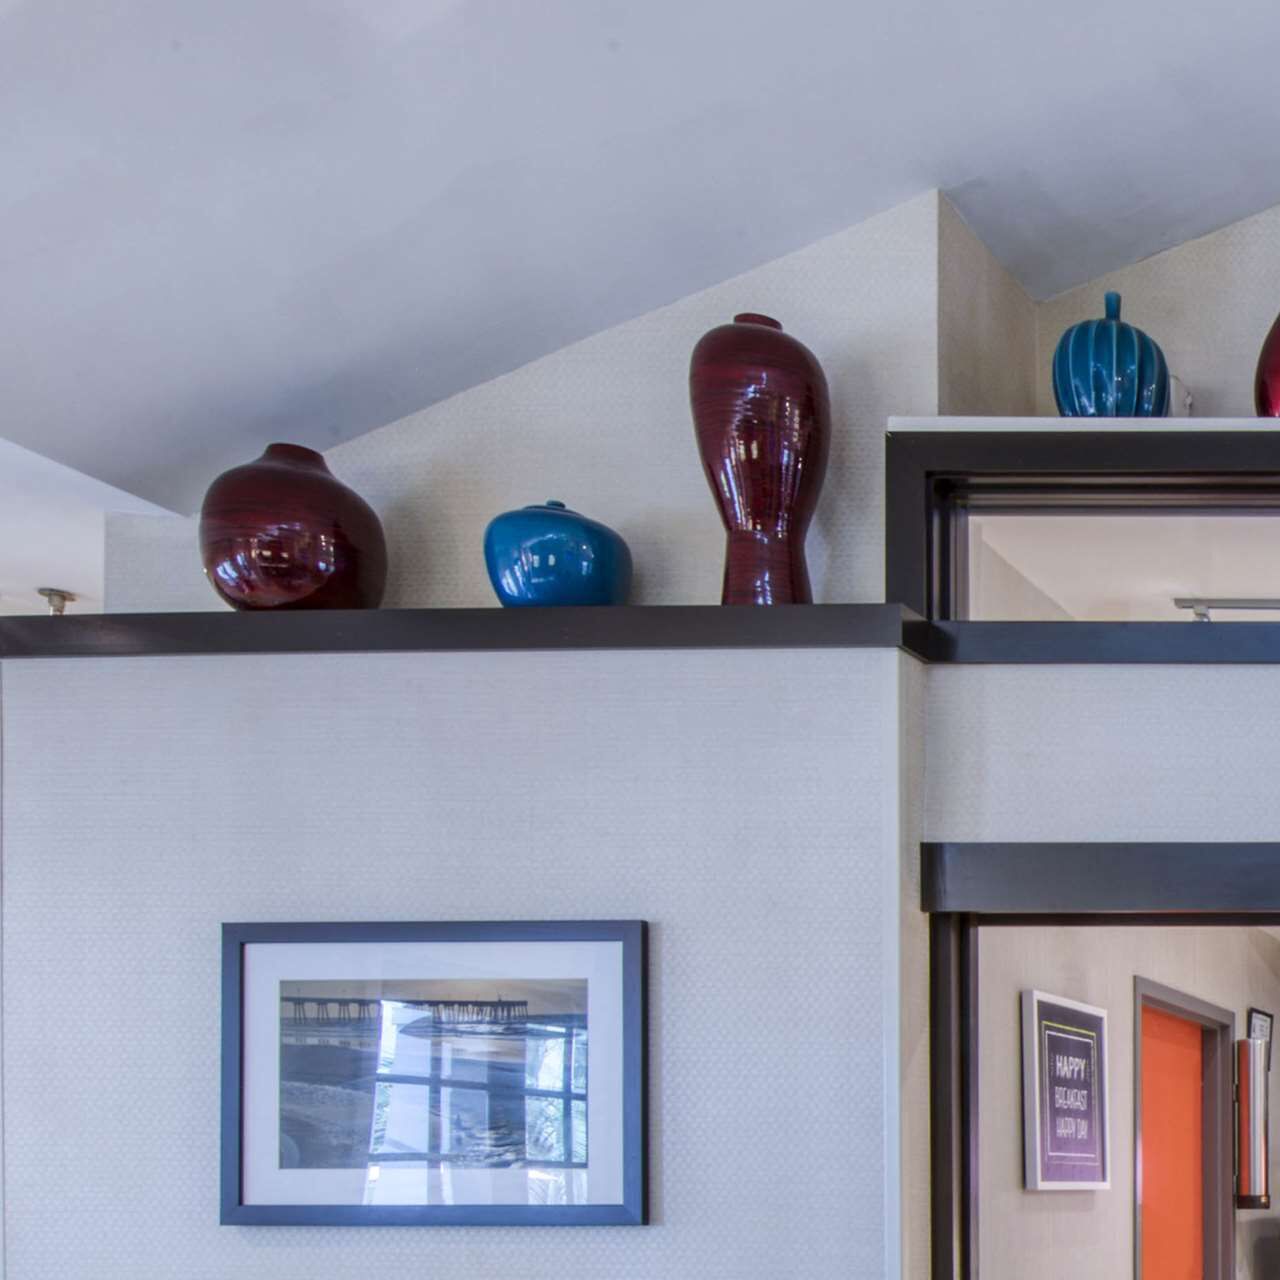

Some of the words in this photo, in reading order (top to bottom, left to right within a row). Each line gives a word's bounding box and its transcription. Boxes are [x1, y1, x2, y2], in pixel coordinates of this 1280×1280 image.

[1055, 1054, 1086, 1080] HAPPY
[1054, 1086, 1088, 1111] BREAKFAST
[1055, 1116, 1076, 1139] HAPPY
[1077, 1117, 1088, 1140] DAY
